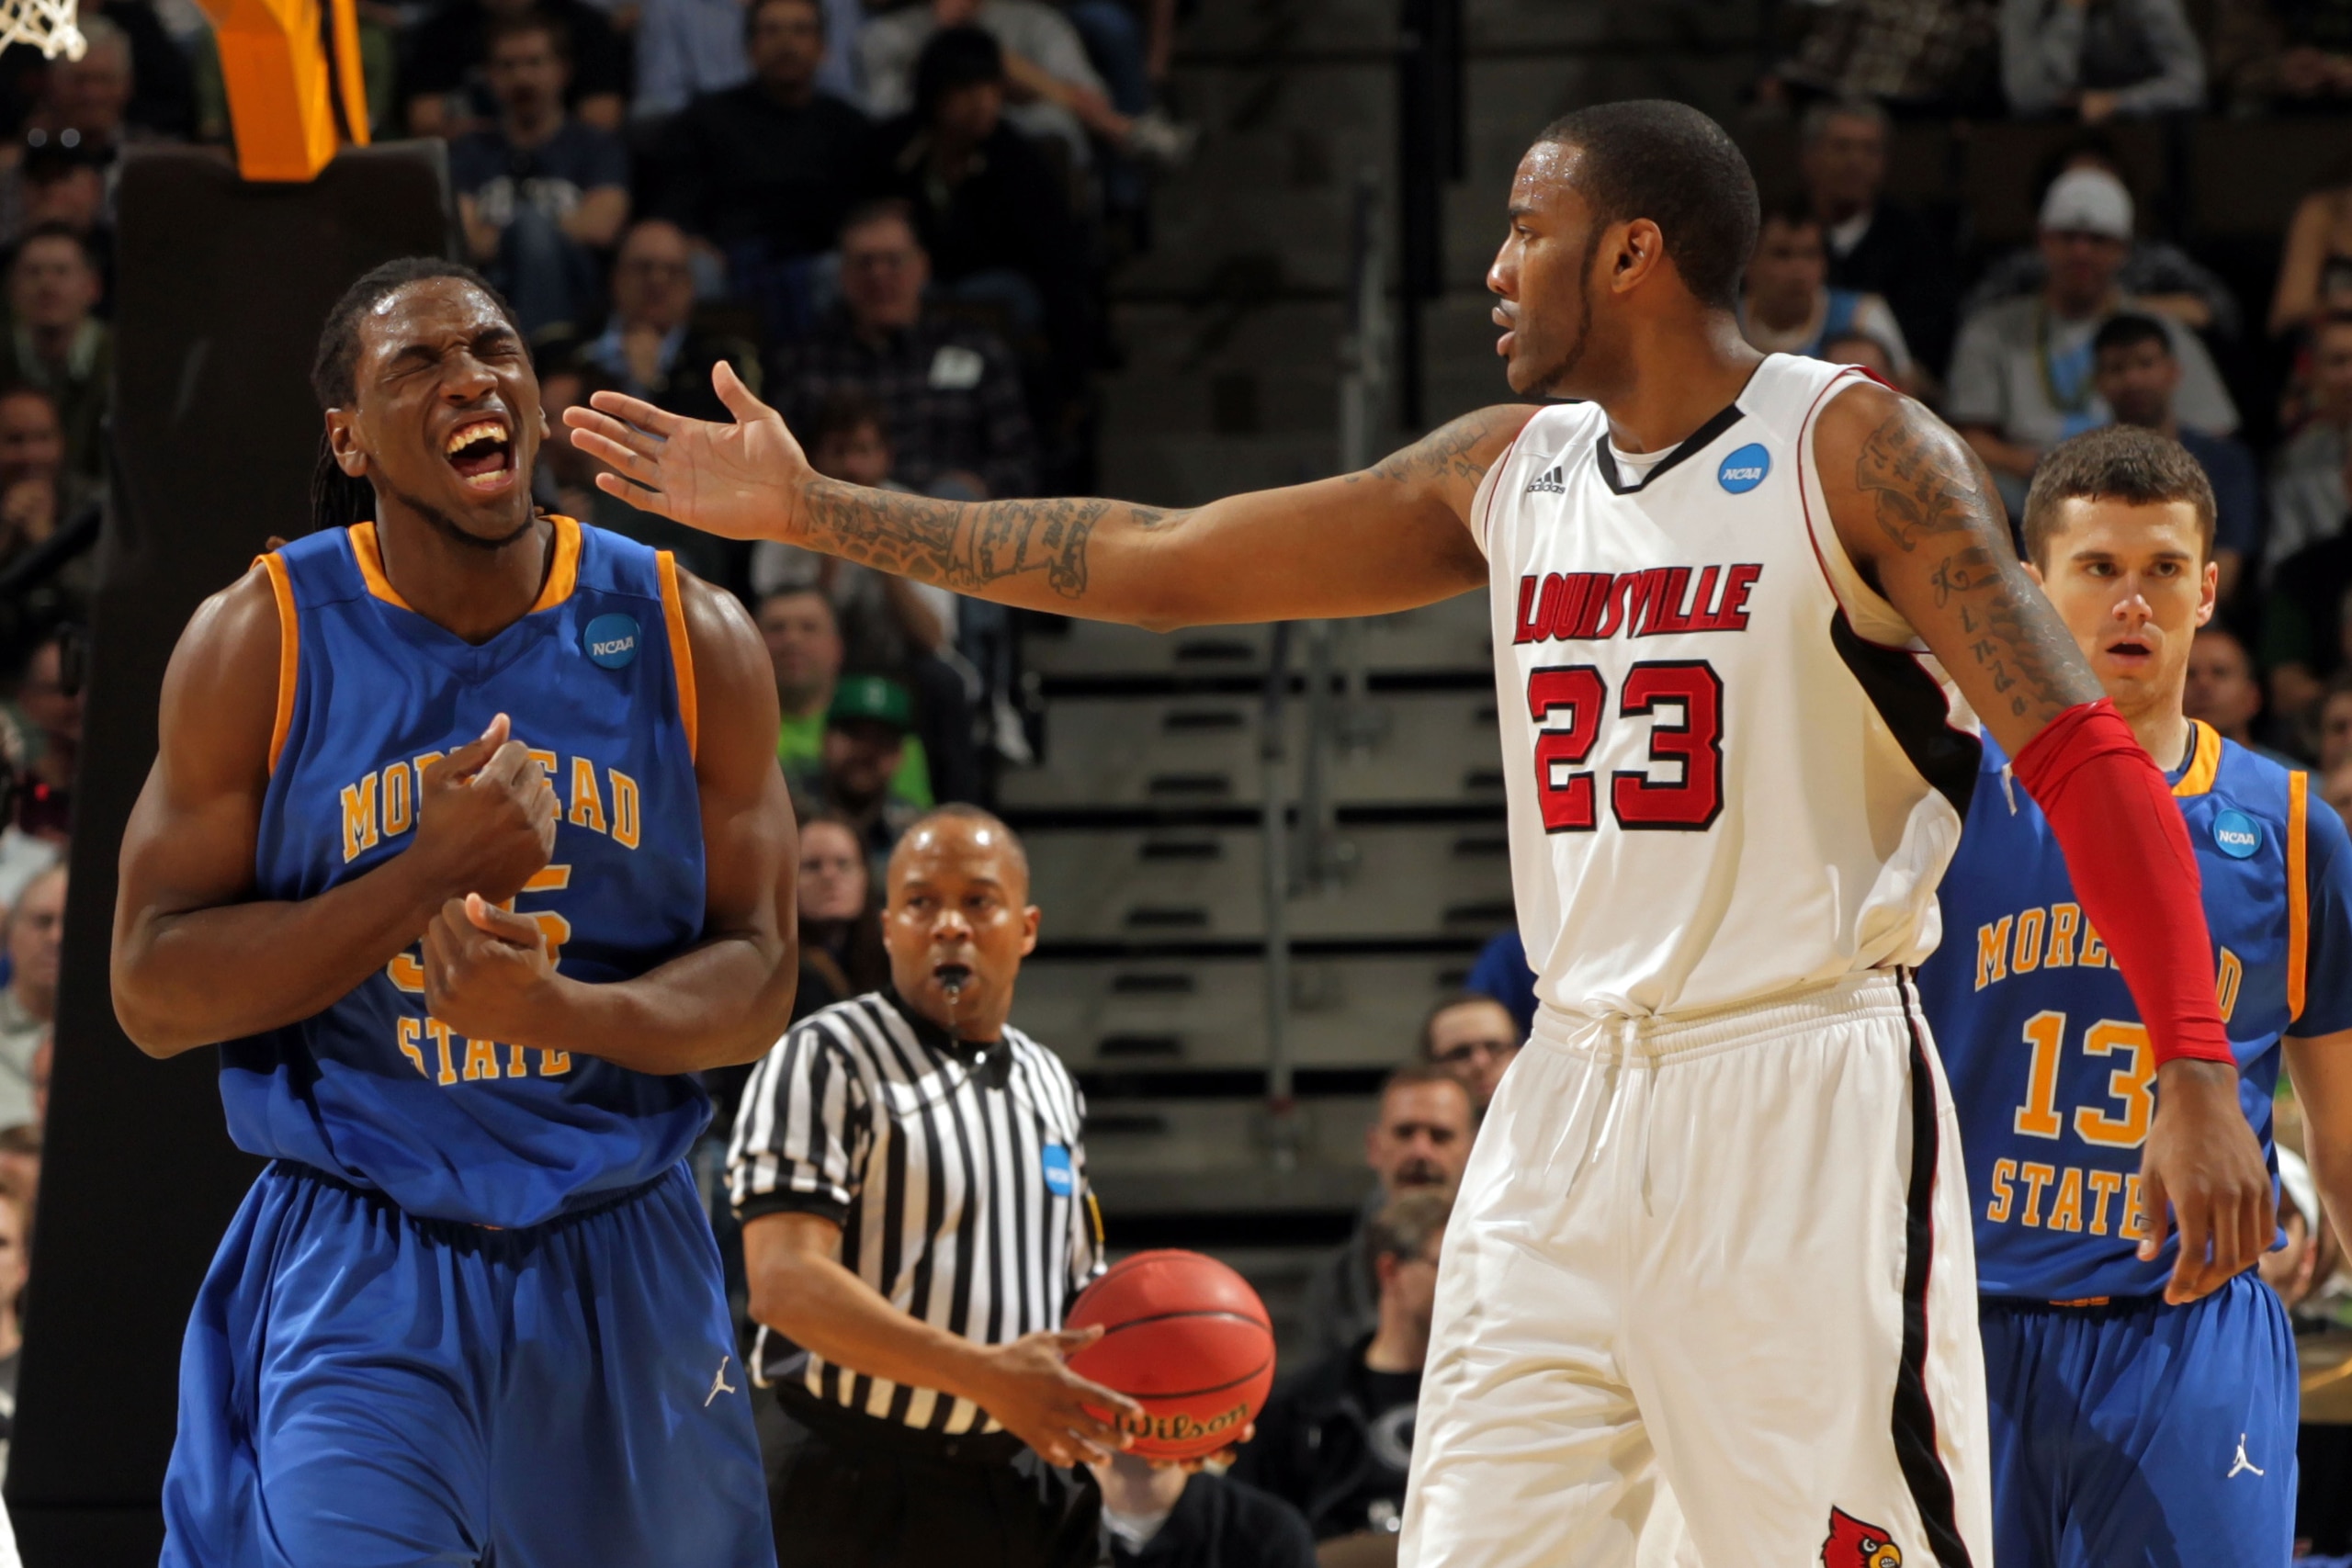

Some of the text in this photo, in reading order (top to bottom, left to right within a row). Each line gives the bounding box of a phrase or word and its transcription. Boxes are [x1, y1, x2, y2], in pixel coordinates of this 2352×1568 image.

[1526, 480, 1566, 495] adidas
[1722, 467, 1762, 480] NCAA
[1512, 564, 1764, 645] LOUISVILLE
[593, 636, 634, 656] NCAA
[1527, 660, 1724, 834] 23
[341, 747, 639, 864] MOEAD
[2219, 829, 2256, 846] NCAA
[1975, 902, 2244, 1024] MORED
[2013, 1010, 2158, 1149] 13
[1114, 1403, 1250, 1440] Wilson
